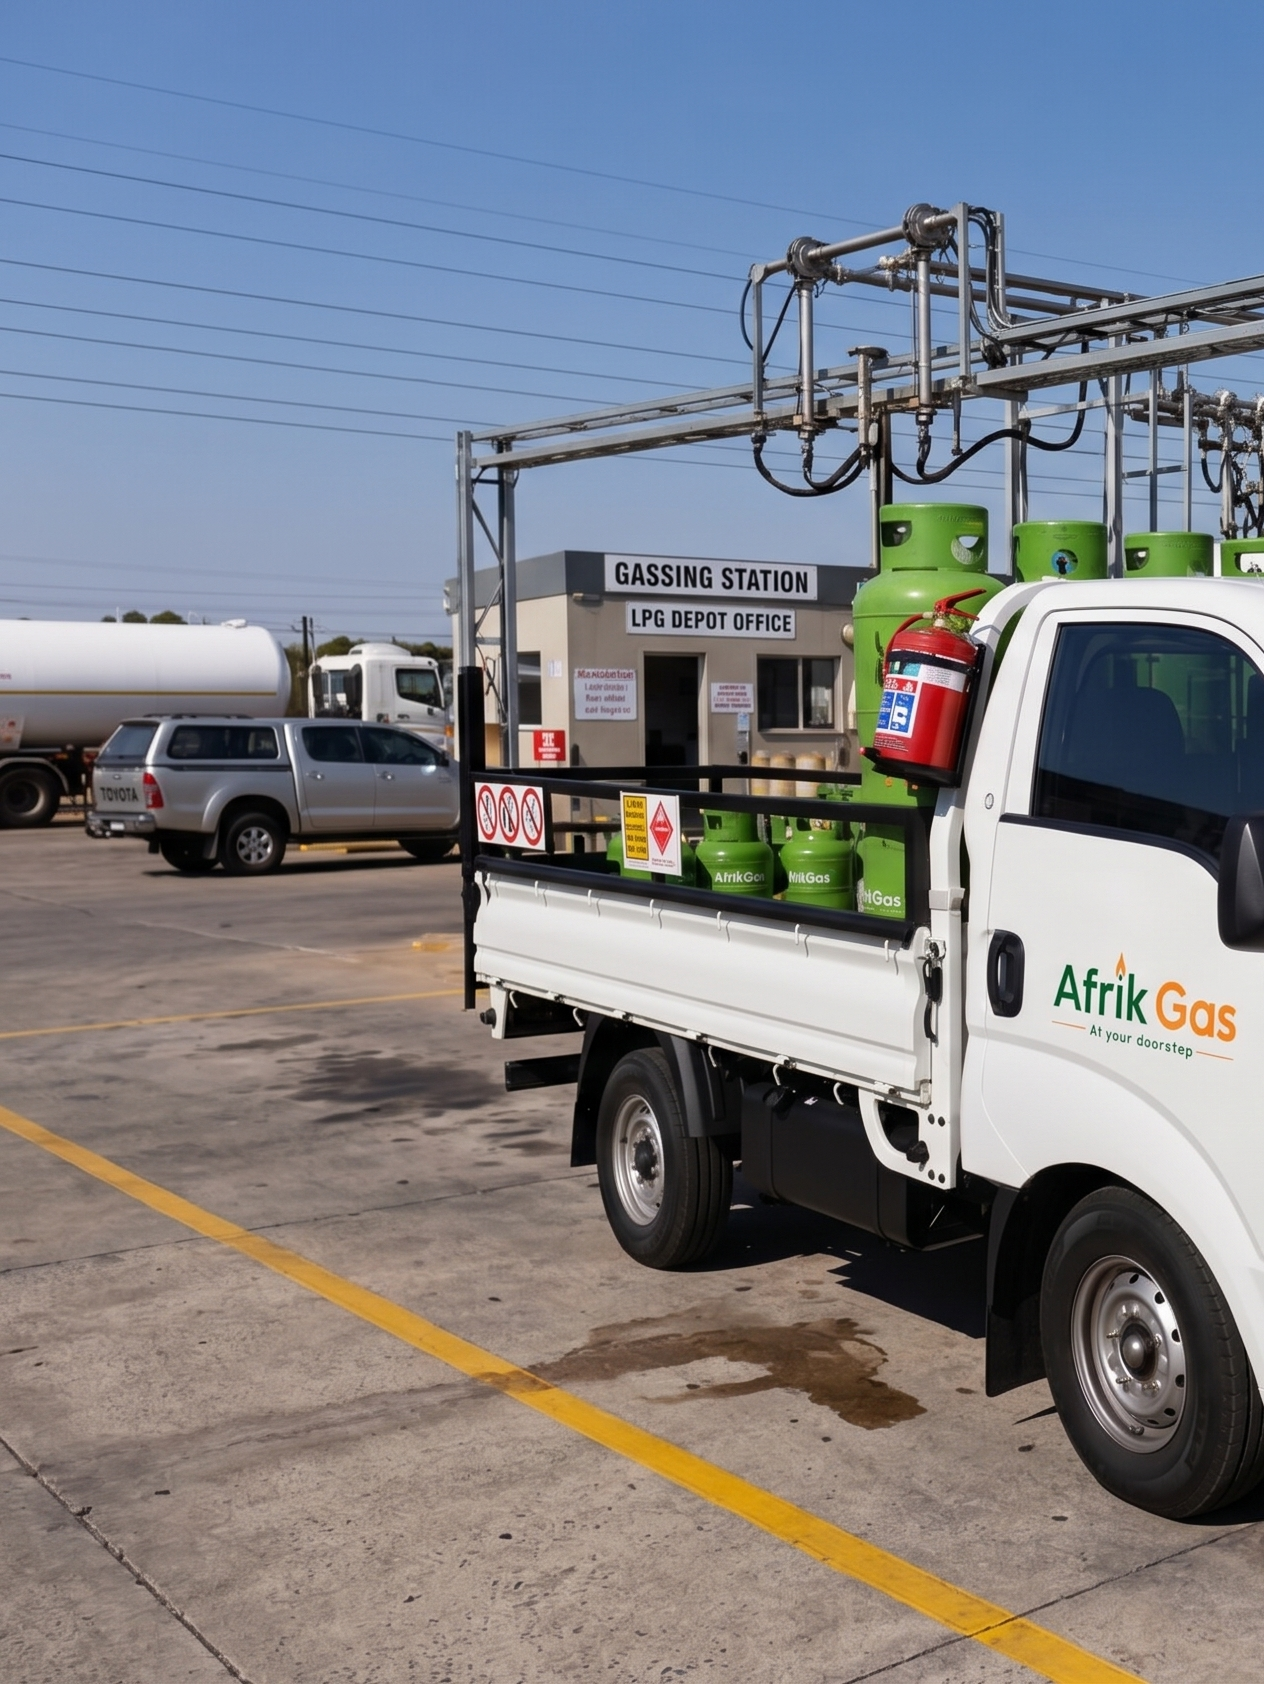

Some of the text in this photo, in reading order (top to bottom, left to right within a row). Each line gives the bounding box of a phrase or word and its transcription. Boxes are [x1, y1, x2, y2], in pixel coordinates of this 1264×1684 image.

[615, 562, 808, 593] GASSING STATION
[631, 608, 792, 632] LPG DEPOT OFFICE
[100, 787, 139, 802] TOYOTA
[1053, 953, 1237, 1042] Afrik Gas
[1090, 1024, 1193, 1059] At your doorstep
